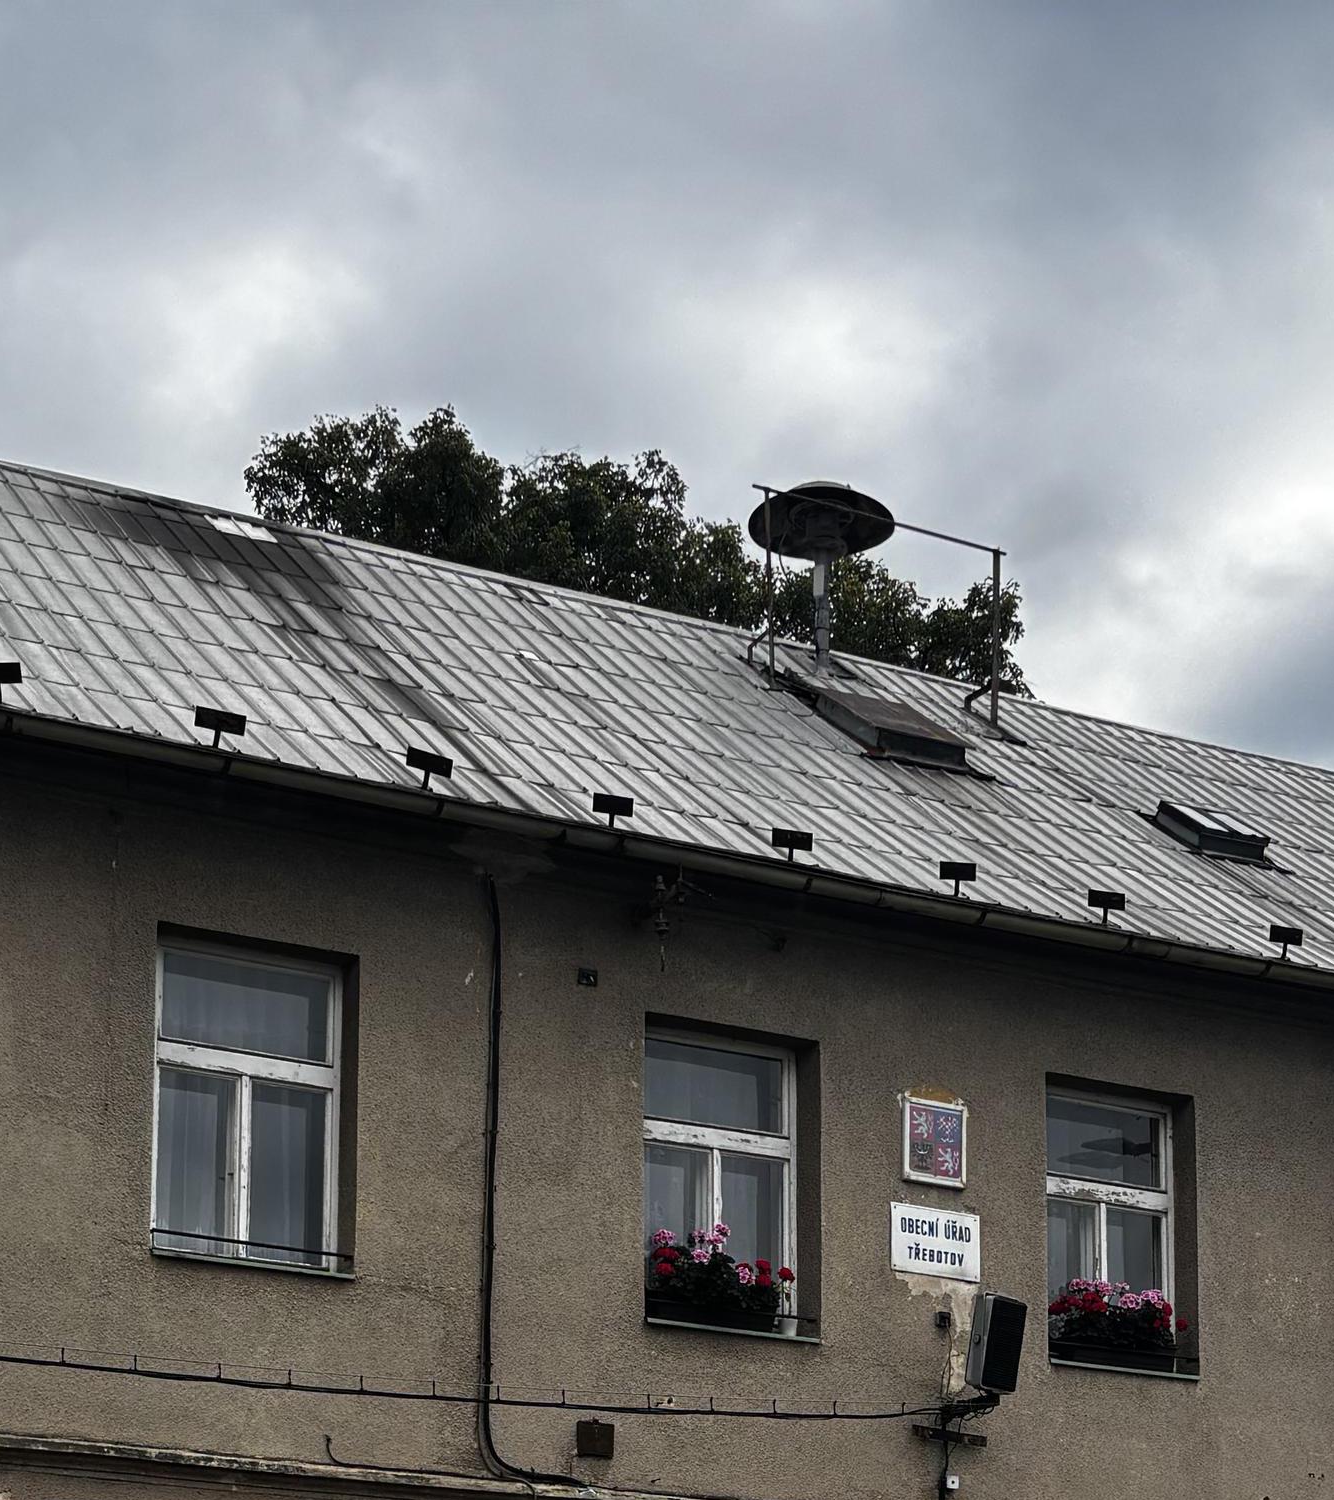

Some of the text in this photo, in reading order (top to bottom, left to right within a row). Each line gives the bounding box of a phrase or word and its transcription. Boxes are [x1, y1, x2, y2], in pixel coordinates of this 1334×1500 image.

[901, 1217, 971, 1243] OBECNÍ ÚŘAD
[907, 1242, 964, 1267] TŘEBOTOV
